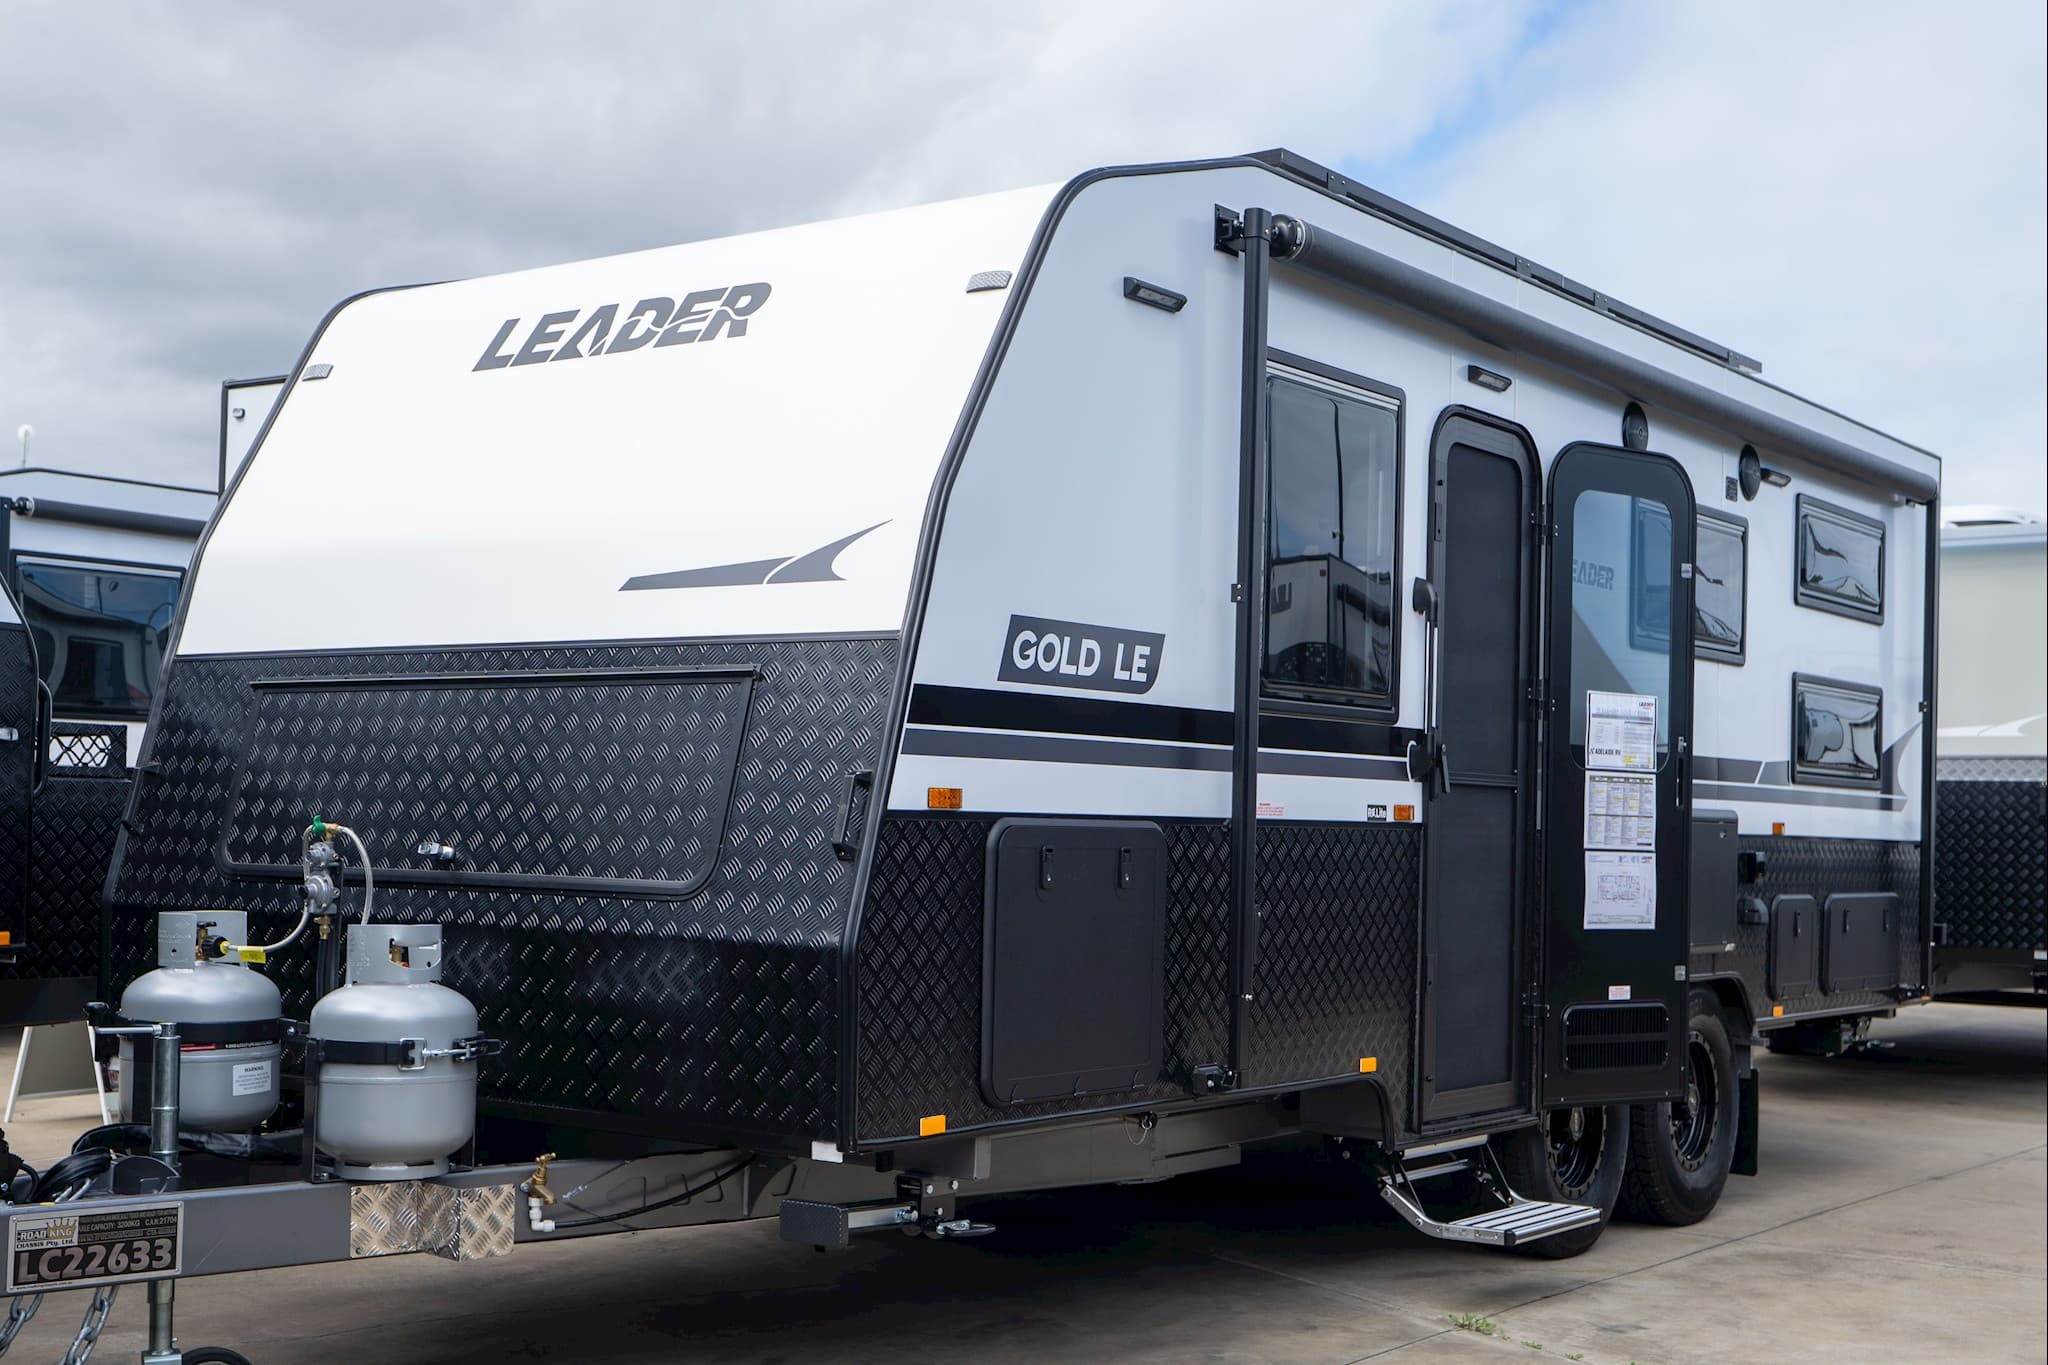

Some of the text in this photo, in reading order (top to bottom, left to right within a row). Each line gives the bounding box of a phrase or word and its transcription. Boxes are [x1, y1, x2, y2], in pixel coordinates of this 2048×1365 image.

[471, 282, 772, 372] LEADER
[1573, 560, 1614, 590] ADER
[1012, 630, 1151, 682] GOLD LE
[16, 1241, 44, 1249] CHASSIS
[21, 1230, 47, 1241] ROAD
[49, 1228, 72, 1238] KING
[17, 1238, 173, 1284] LC22633
